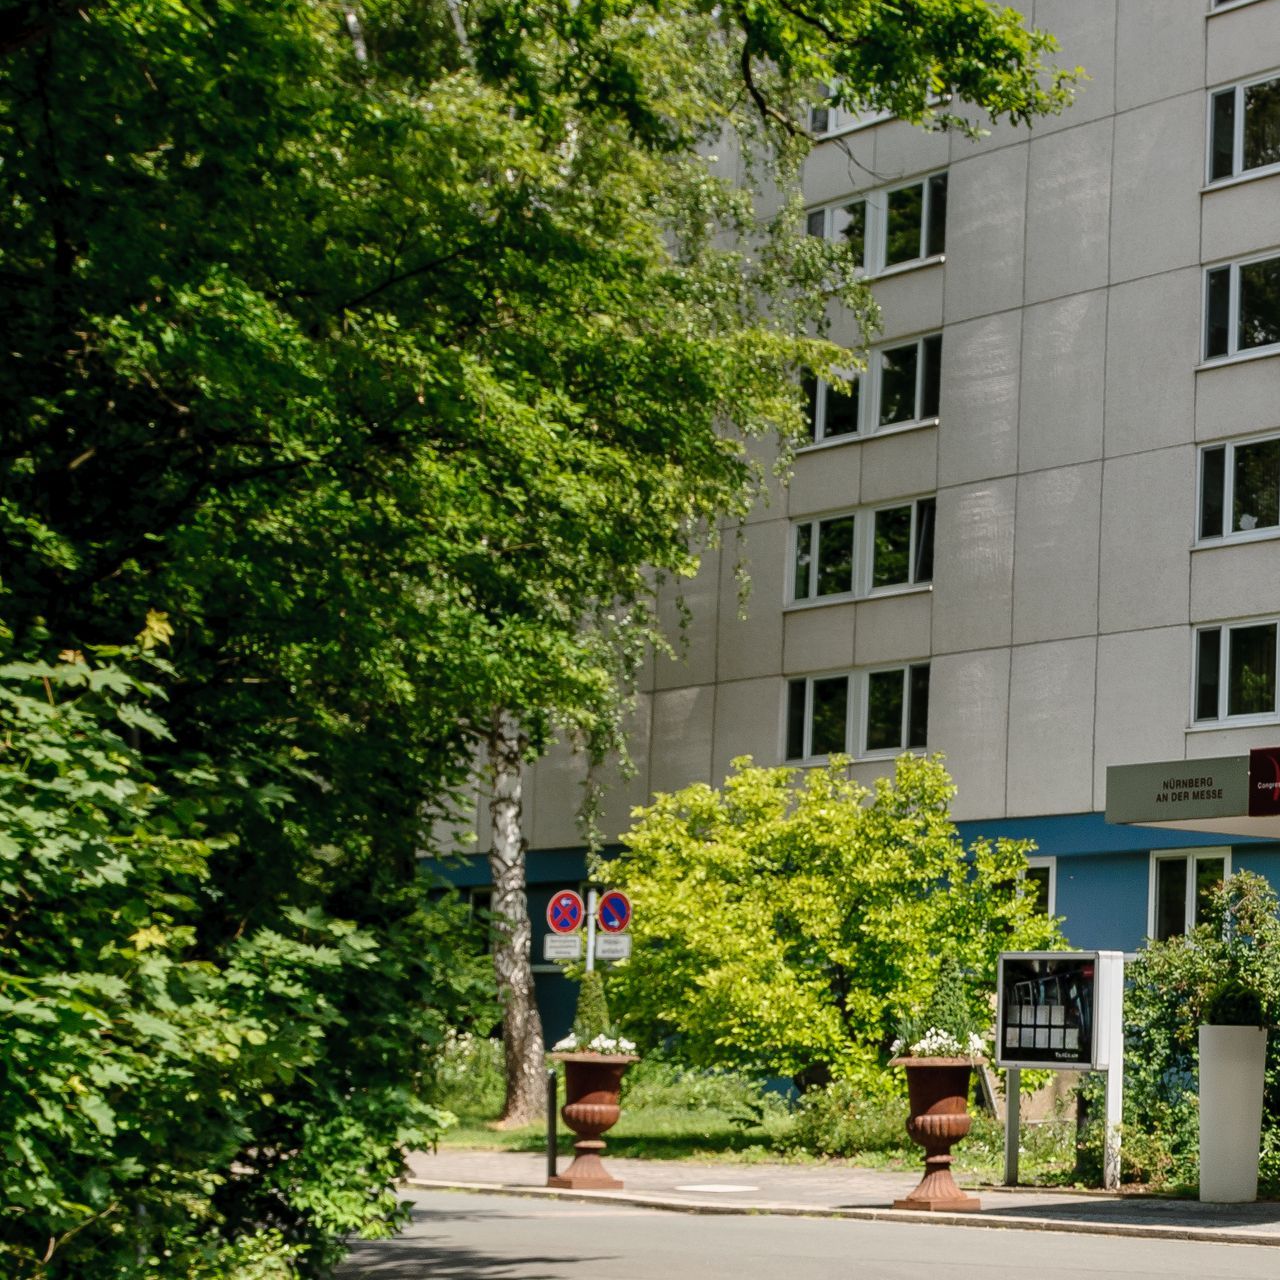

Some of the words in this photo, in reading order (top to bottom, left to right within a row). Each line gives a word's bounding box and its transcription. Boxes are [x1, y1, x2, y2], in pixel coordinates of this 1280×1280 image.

[1163, 776, 1213, 790] NÜRNBERG
[1156, 792, 1168, 803] AN
[1171, 791, 1189, 802] DER
[1192, 789, 1223, 800] MESSE
